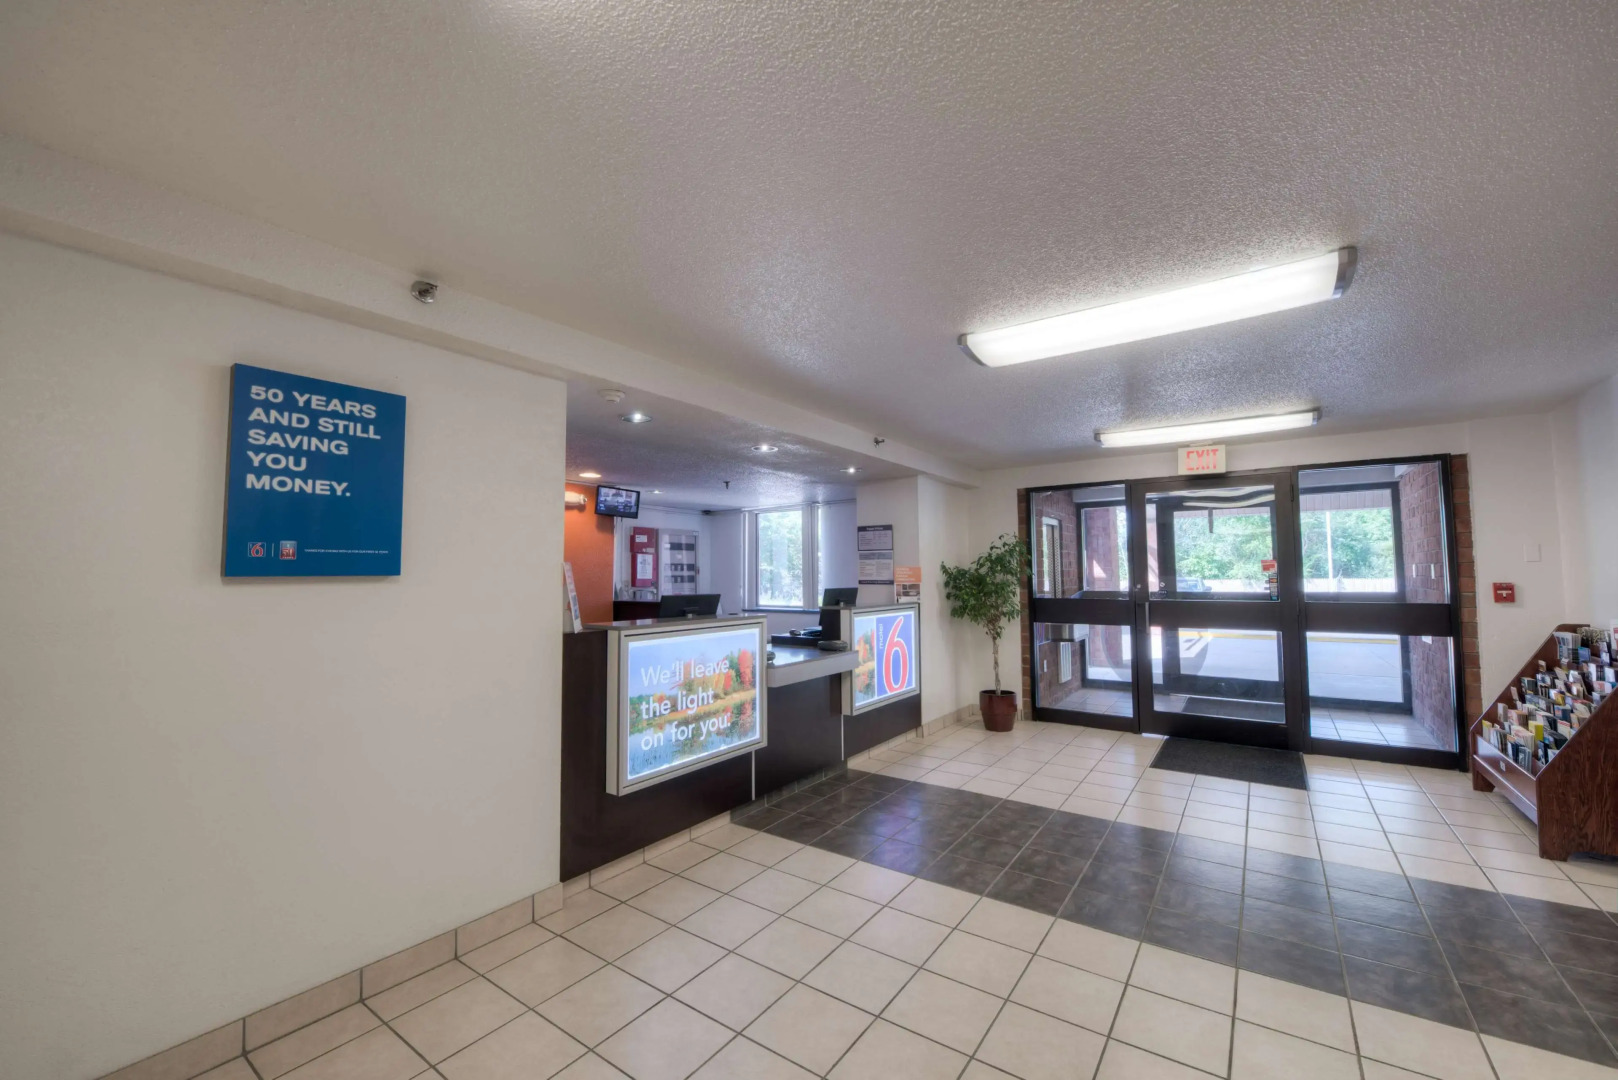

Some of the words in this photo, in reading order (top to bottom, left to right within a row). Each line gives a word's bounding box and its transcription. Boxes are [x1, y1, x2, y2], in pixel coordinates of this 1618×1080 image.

[250, 385, 284, 403] 50
[293, 391, 377, 419] YEARS
[248, 407, 310, 429] AND
[318, 418, 381, 440] STILL
[247, 429, 349, 455] SAVING
[246, 450, 307, 472] YOU
[1186, 448, 1219, 470] EXIT
[246, 474, 351, 497] MONEY.
[883, 616, 909, 694] 6
[640, 660, 684, 687] We'll
[690, 658, 730, 679] leave
[640, 696, 671, 720] the
[677, 686, 714, 714] light
[641, 732, 664, 751] on
[671, 720, 696, 743] for
